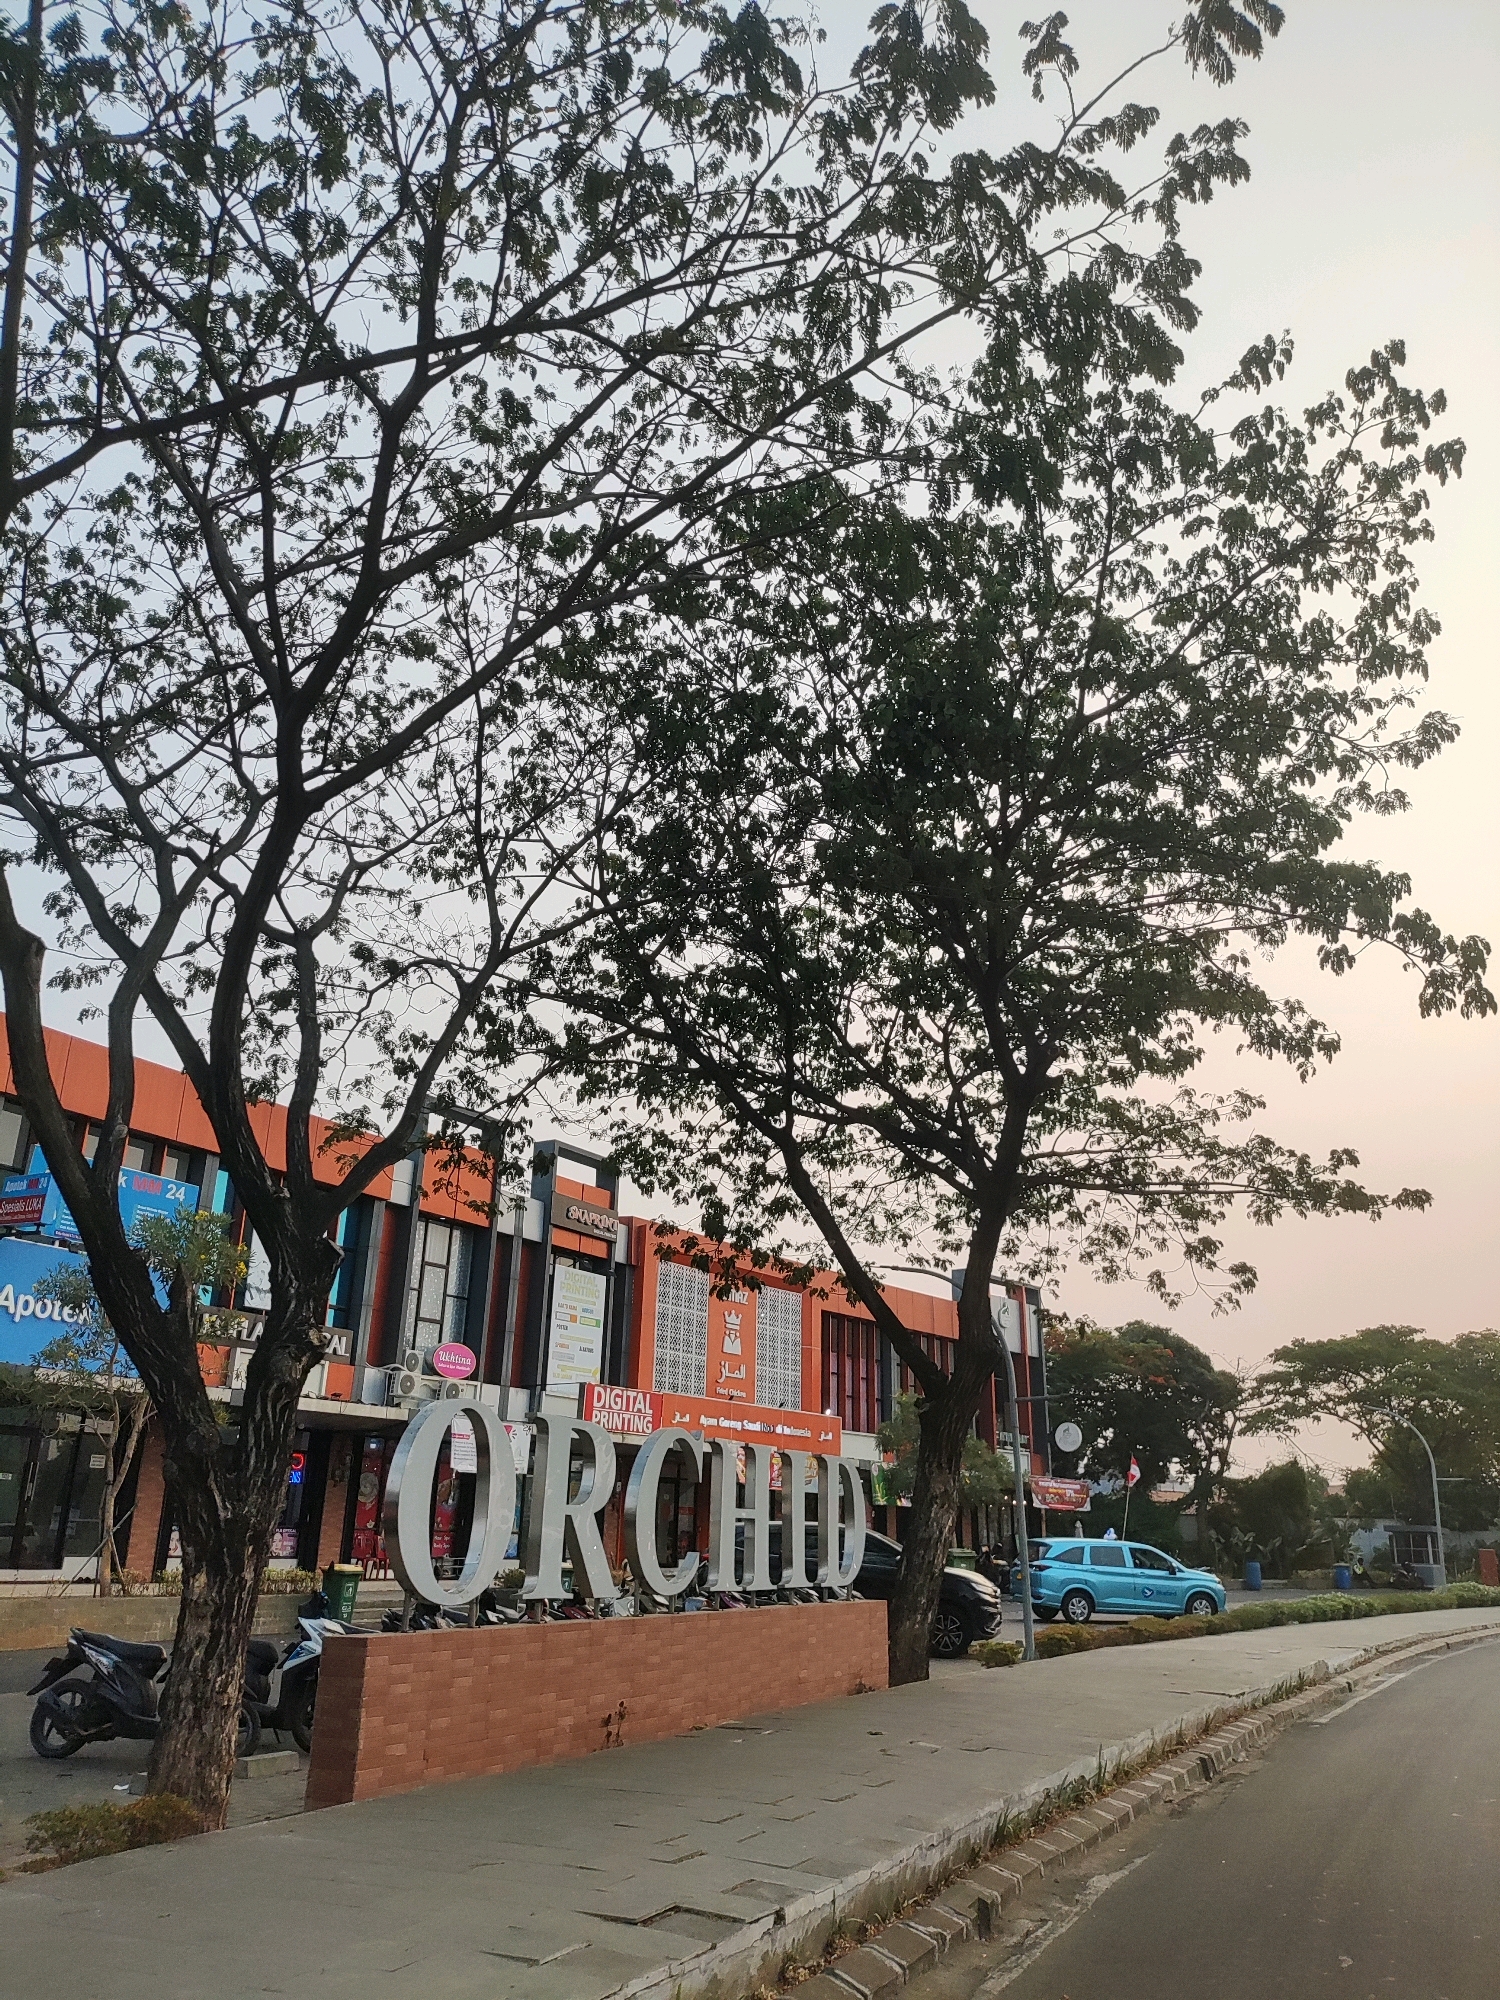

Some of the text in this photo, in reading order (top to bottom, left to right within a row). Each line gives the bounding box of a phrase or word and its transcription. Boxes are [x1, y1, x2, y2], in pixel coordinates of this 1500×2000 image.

[5, 1179, 27, 1192] Apotek
[39, 1177, 48, 1189] 24
[133, 1175, 162, 1195] MM
[165, 1184, 185, 1201] 24
[26, 1198, 42, 1211] LUKA
[564, 1270, 598, 1287] DIGITAL
[559, 1280, 600, 1299] PRINTING
[439, 1351, 471, 1365] Ukhtina
[593, 1386, 653, 1414] DIGITAL
[716, 1386, 746, 1397] Fried Chicken
[592, 1409, 652, 1433] PRINTING
[699, 1414, 718, 1428] Ayam
[718, 1416, 742, 1431] Goreng
[743, 1419, 761, 1431] Saudi
[384, 1398, 866, 1606] ORCHID
